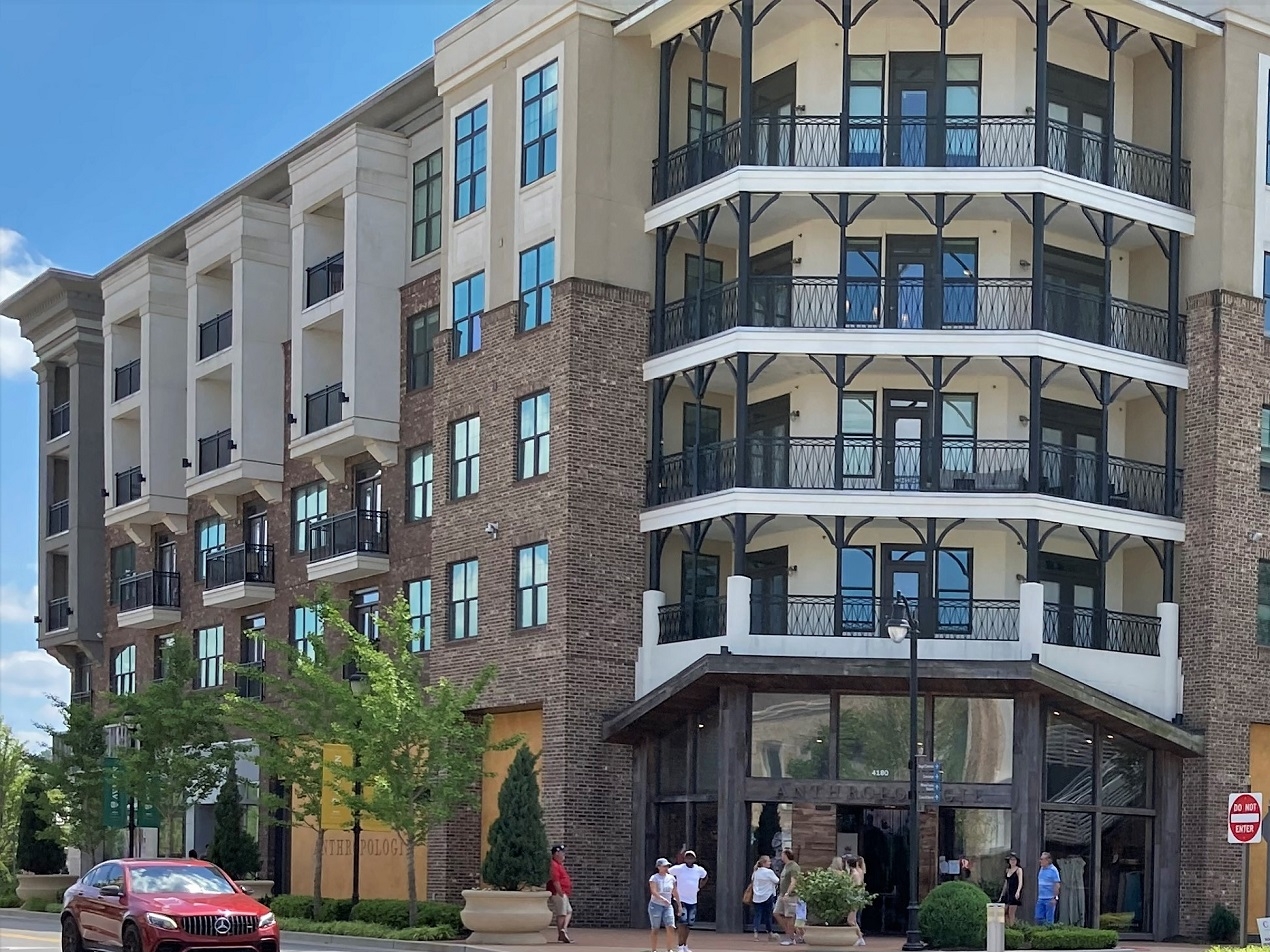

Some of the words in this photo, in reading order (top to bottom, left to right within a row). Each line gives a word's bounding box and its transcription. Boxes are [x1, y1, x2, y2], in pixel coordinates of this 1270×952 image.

[776, 785, 986, 801] ANTHROPOGIE
[1233, 803, 1243, 812] DO
[1245, 802, 1257, 811] NOT
[1235, 824, 1255, 833] ENTER
